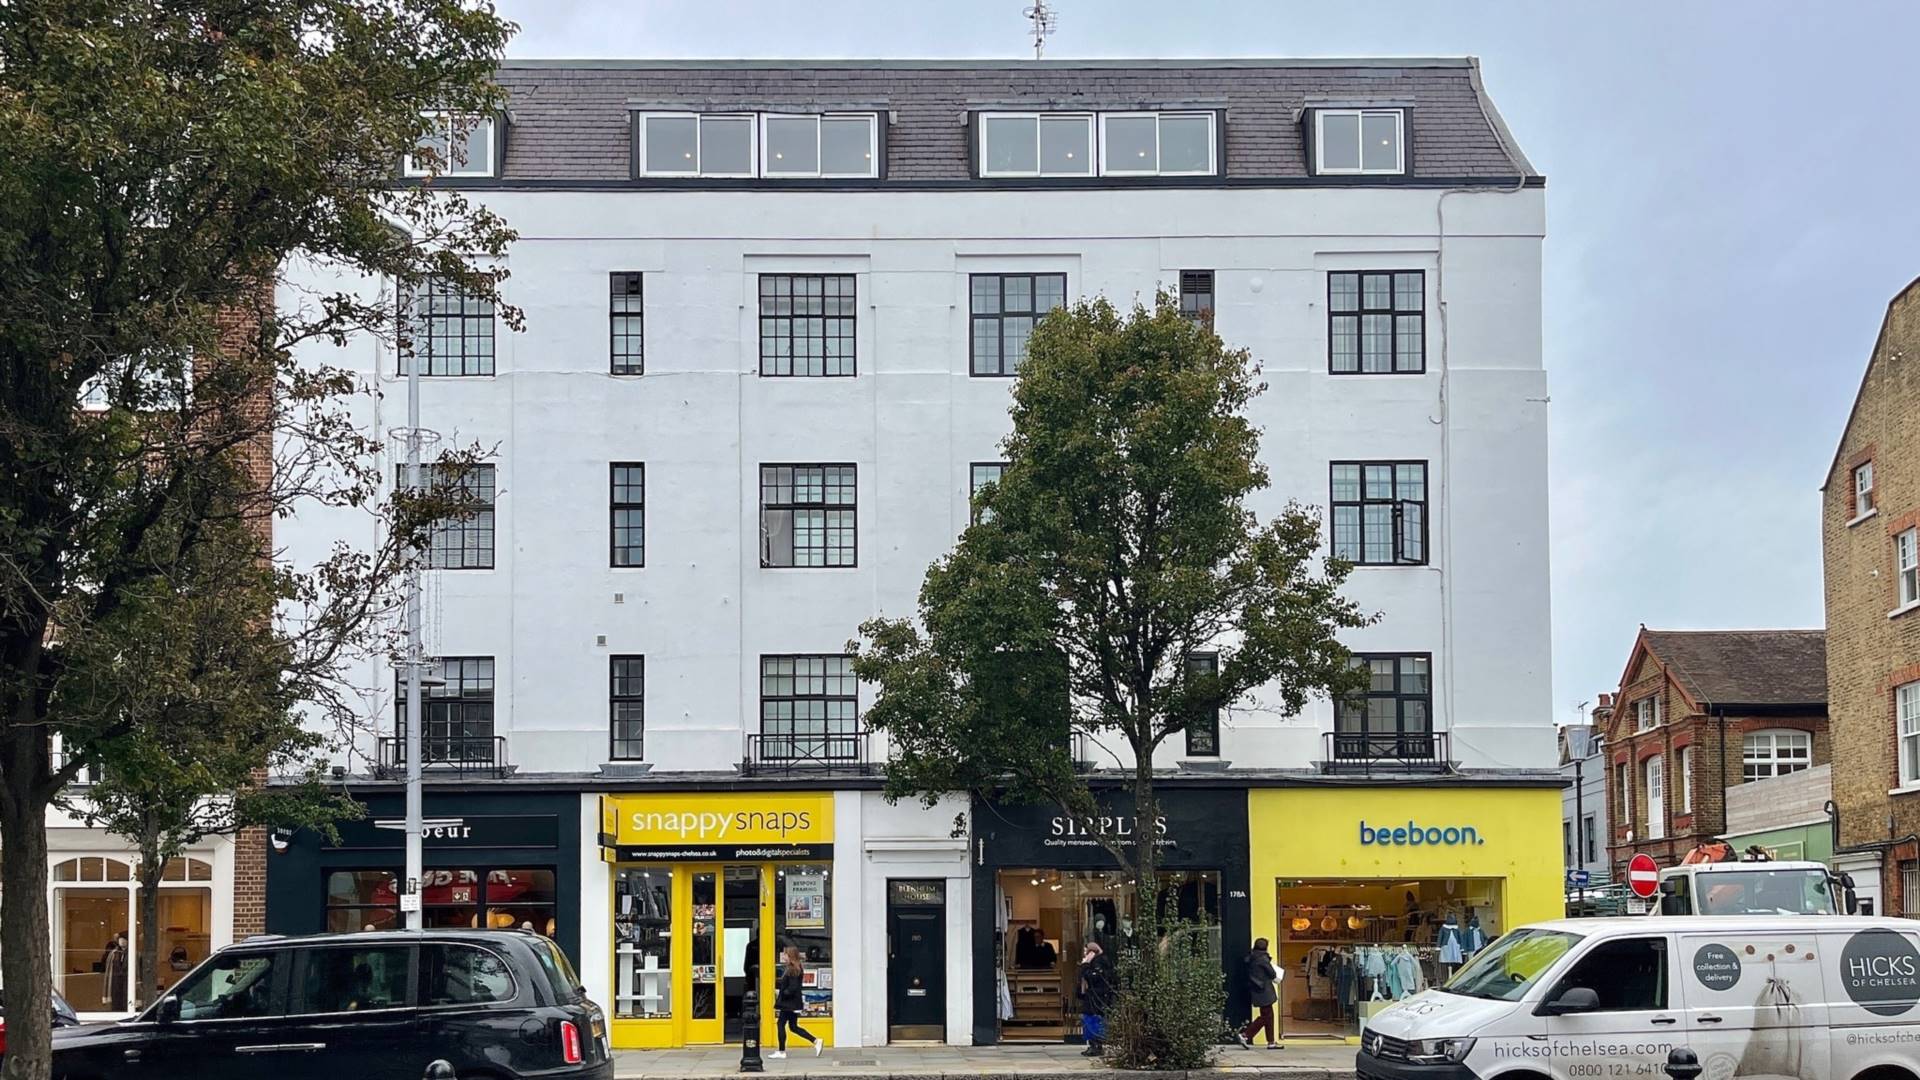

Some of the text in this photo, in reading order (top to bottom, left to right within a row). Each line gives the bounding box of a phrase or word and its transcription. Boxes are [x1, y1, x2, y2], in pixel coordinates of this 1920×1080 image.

[1051, 816, 1168, 836] SIPLS
[421, 826, 471, 839] oeur
[1360, 820, 1484, 846] beeboon.
[1044, 839, 1066, 847] Quality
[632, 850, 717, 859] www.snappysnaps-chelsea.co.uk
[1230, 890, 1247, 898] 178A
[1707, 952, 1724, 960] Free
[1696, 962, 1739, 971] collection &
[1849, 955, 1916, 978] HICKS
[1705, 973, 1733, 983] delivery
[1852, 977, 1917, 987] OF CHELSEA
[1494, 1040, 1673, 1058] hicksofchelsea.com
[1568, 1064, 1602, 1077] 0800
[1608, 1063, 1630, 1076] 121
